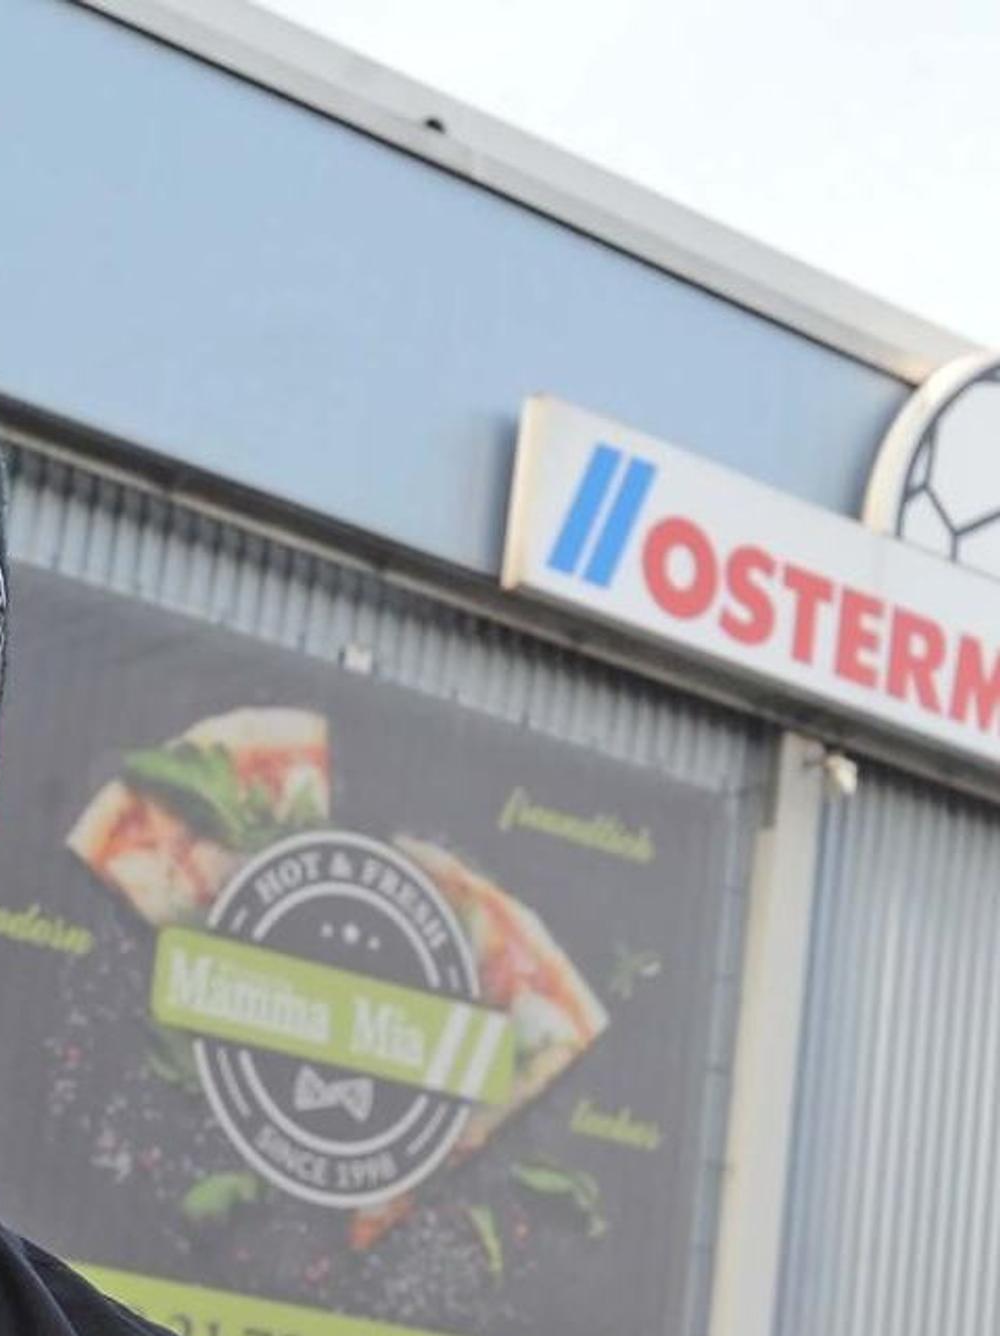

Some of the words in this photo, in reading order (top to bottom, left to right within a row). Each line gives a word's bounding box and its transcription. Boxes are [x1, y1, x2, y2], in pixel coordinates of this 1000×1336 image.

[641, 515, 1000, 737] OSTERM
[254, 852, 322, 903] HOT
[361, 858, 448, 949] FRESH
[254, 1124, 327, 1187] SINCE
